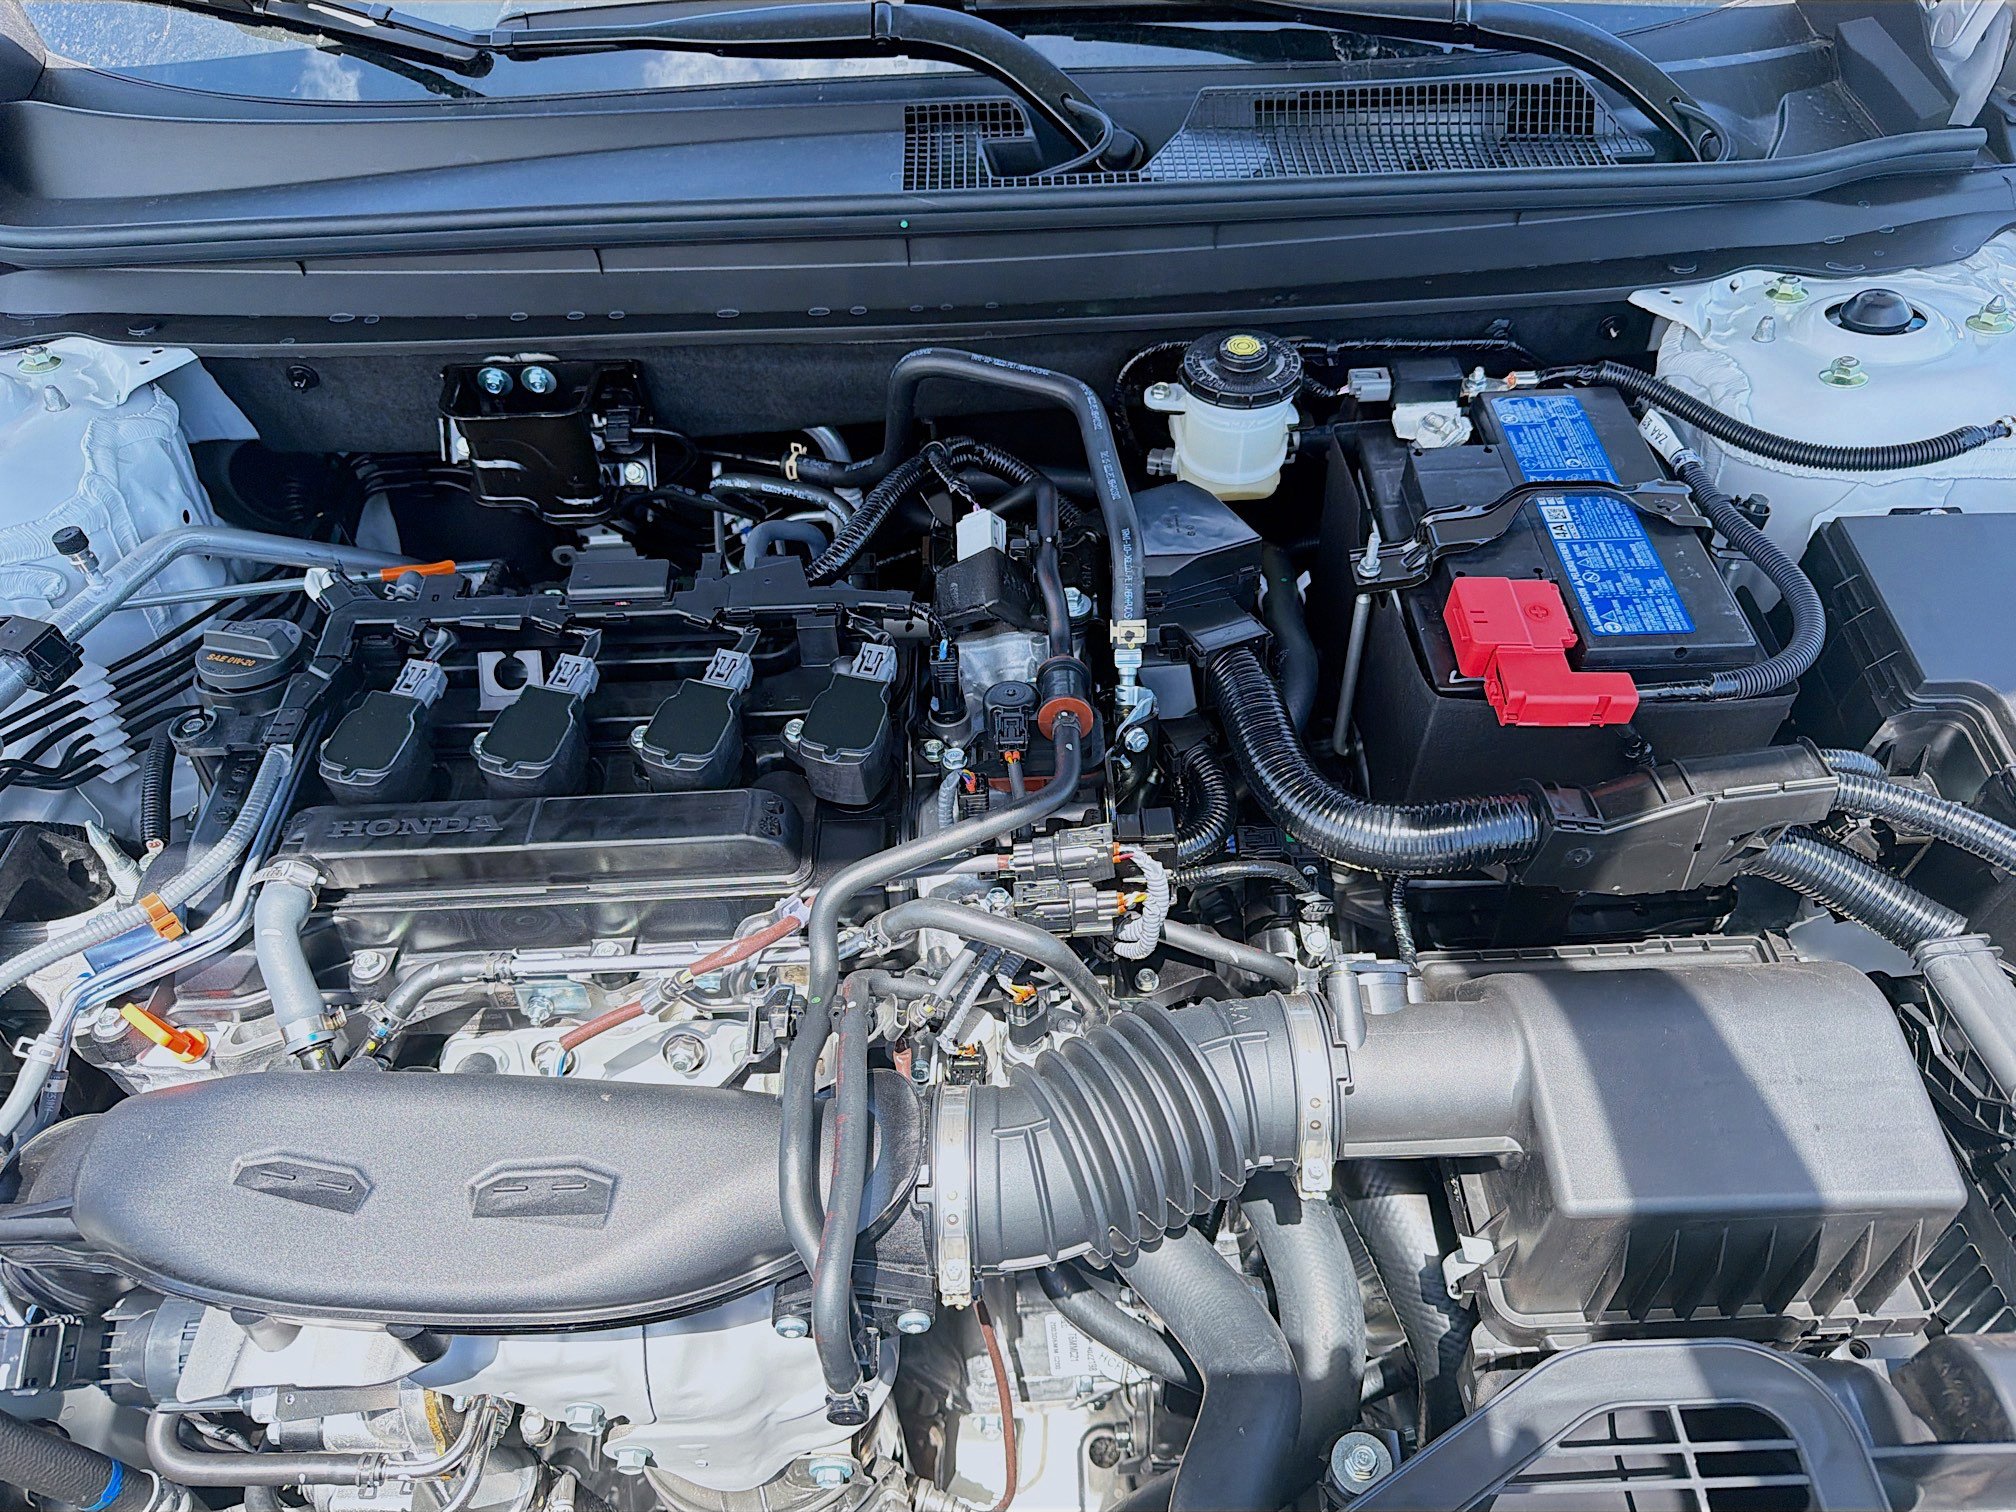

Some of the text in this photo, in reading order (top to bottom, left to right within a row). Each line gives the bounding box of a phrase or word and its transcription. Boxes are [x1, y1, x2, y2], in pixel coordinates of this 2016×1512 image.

[1552, 524, 1568, 538] 4A
[207, 653, 256, 667] SAE 0W-20
[327, 814, 503, 838] HONDA
